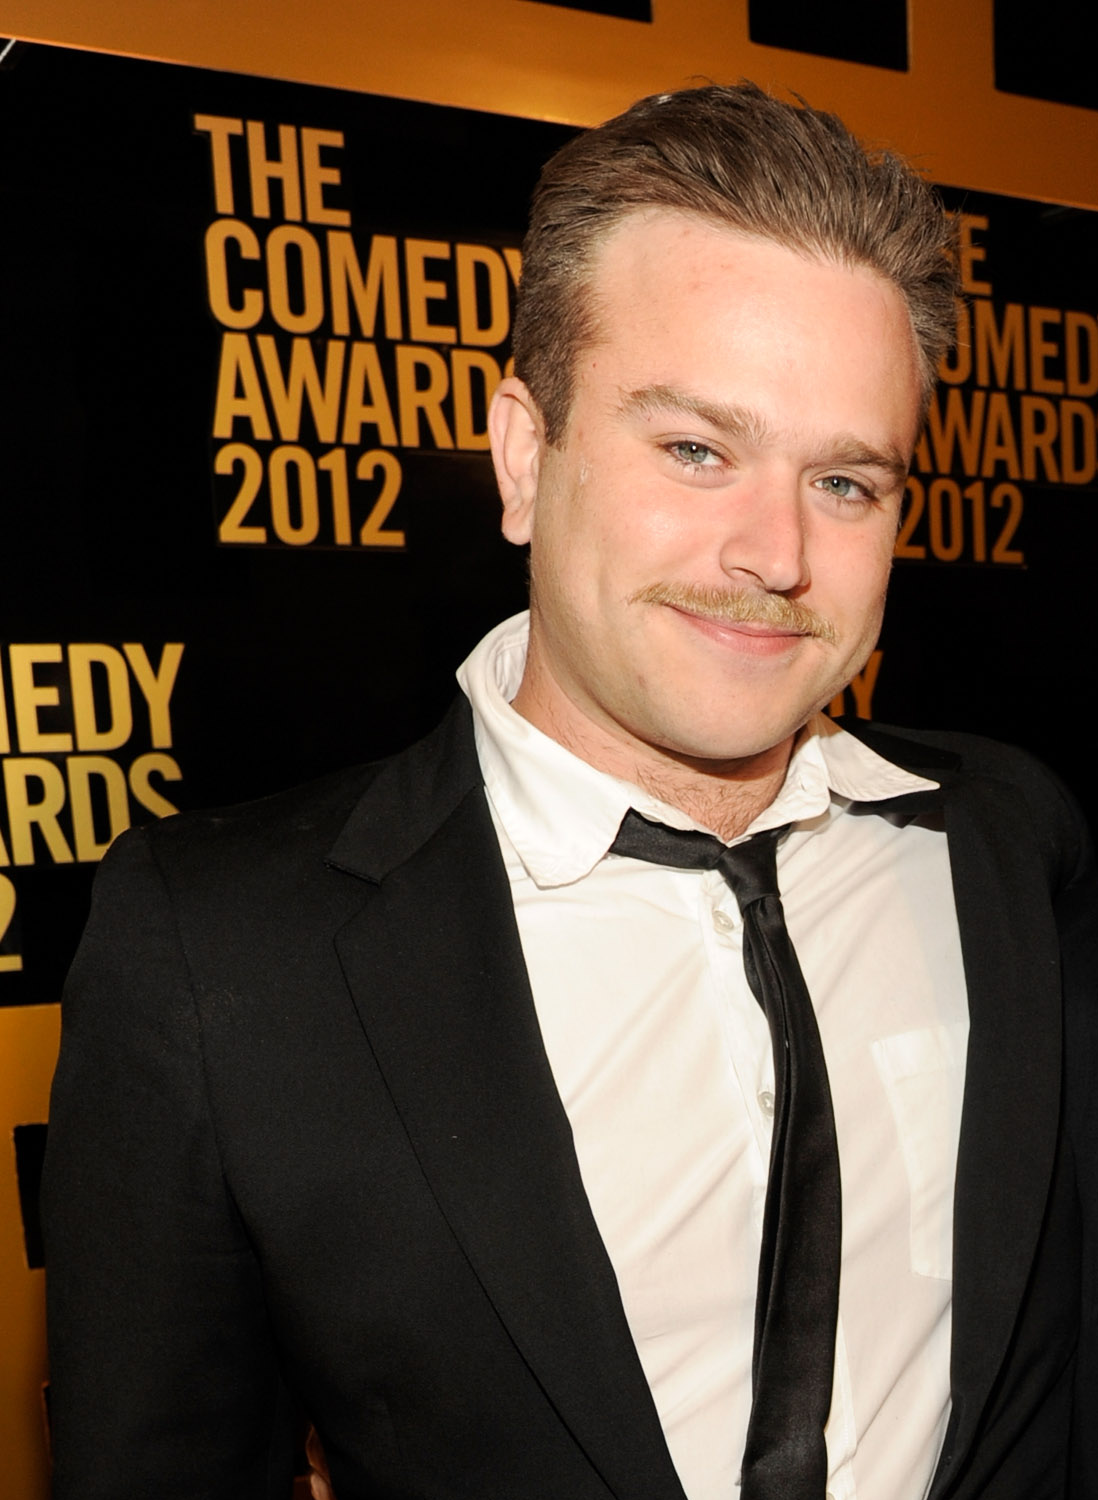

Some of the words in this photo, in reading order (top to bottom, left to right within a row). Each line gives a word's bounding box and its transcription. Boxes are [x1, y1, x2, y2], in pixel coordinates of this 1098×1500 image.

[193, 112, 352, 229] THE
[211, 331, 516, 453] AWARD
[213, 442, 407, 547] 2012
